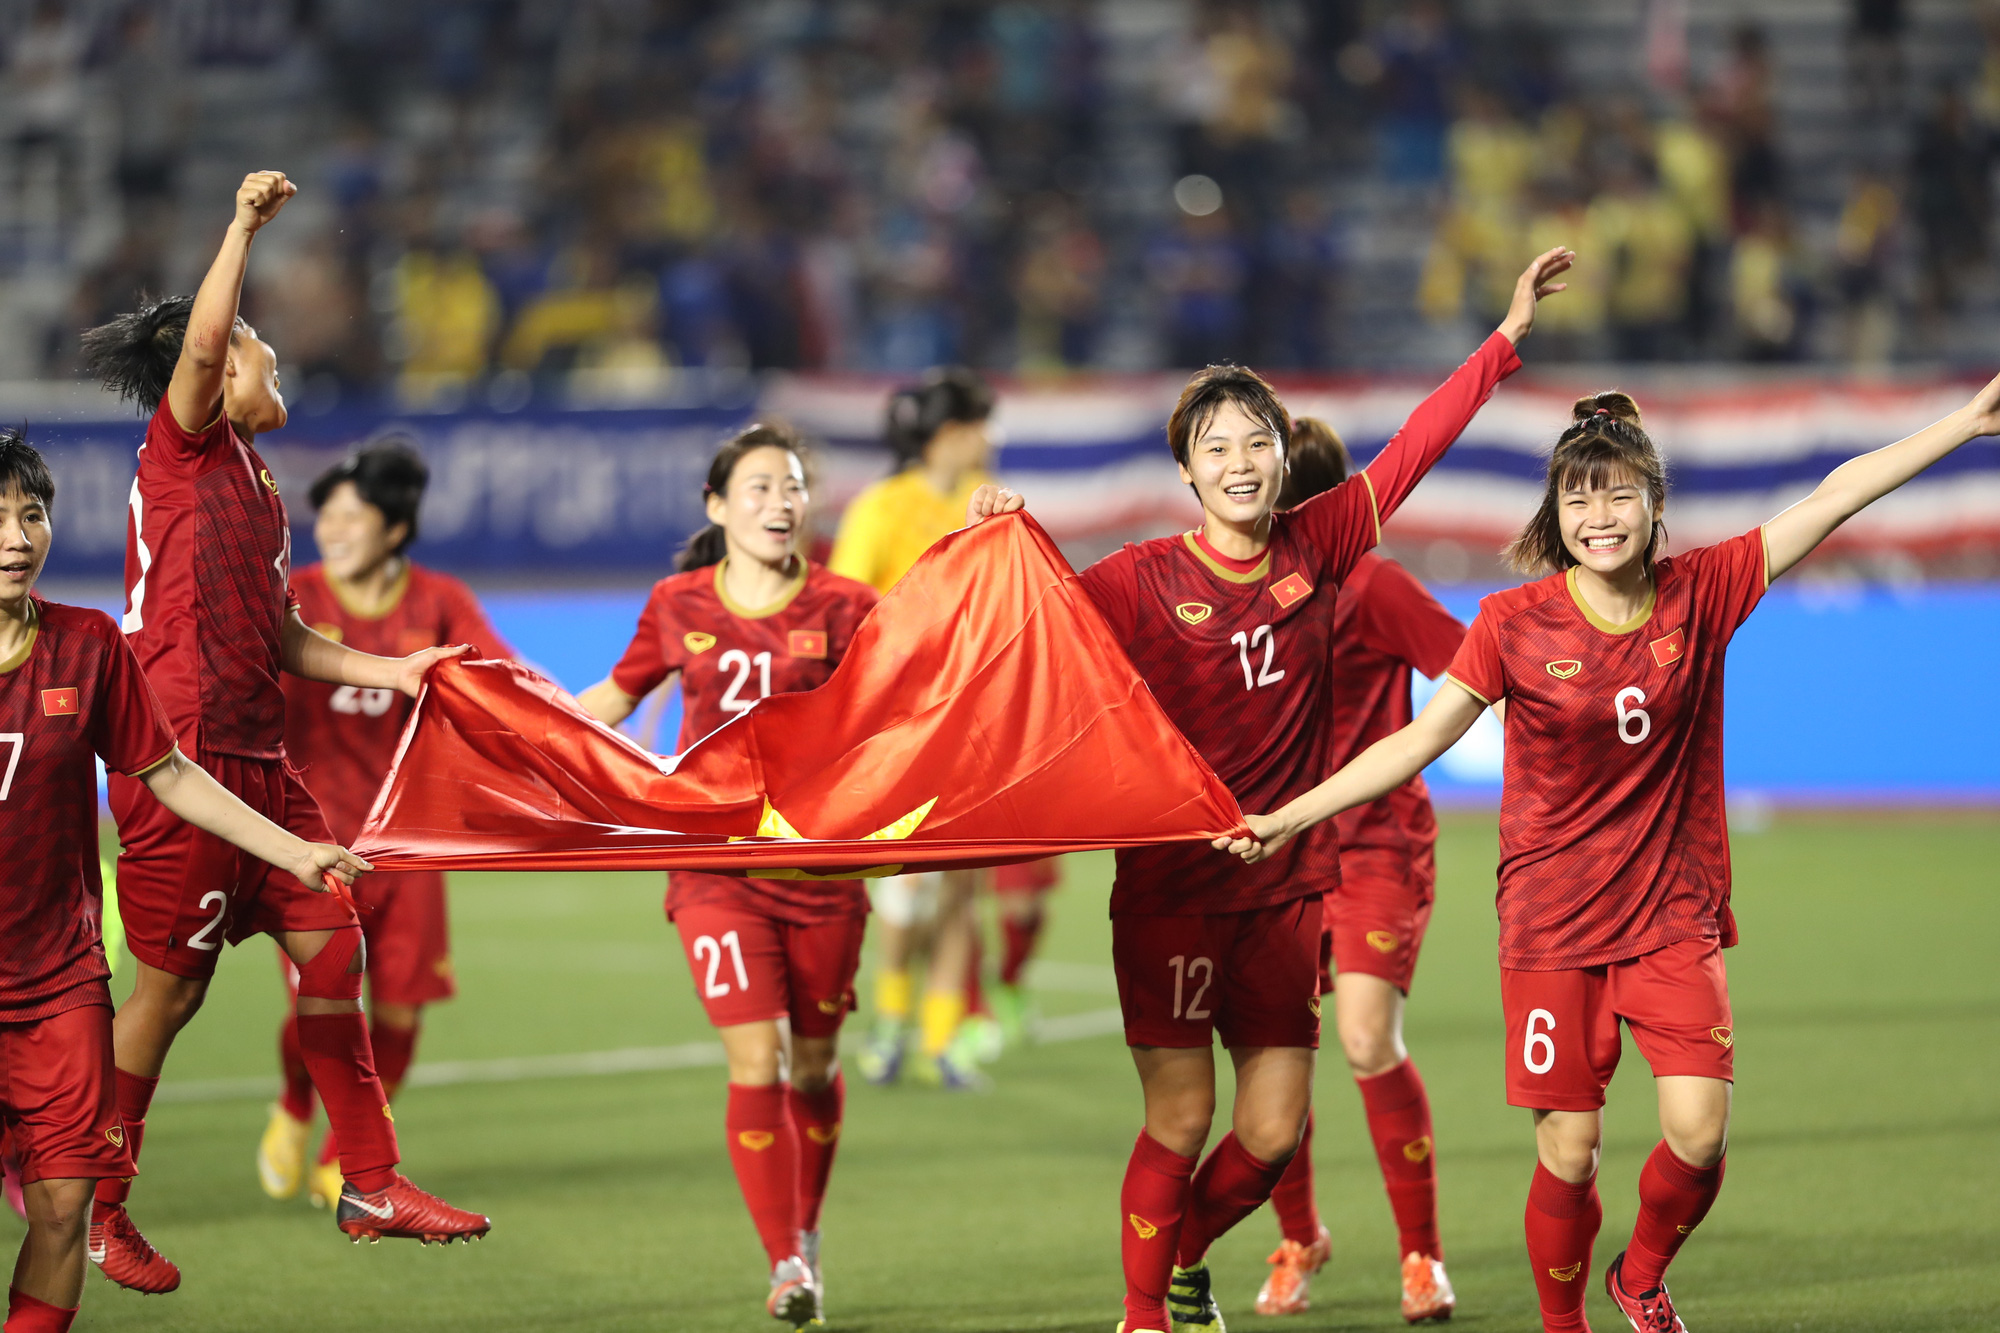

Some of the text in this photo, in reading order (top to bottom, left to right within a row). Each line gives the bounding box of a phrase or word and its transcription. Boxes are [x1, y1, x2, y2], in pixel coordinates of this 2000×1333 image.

[718, 649, 772, 712] 21
[1230, 624, 1286, 691] 12
[1614, 686, 1651, 745] 6
[693, 930, 749, 999] 21
[1168, 955, 1214, 1020] 12
[1523, 1008, 1556, 1075] 6
